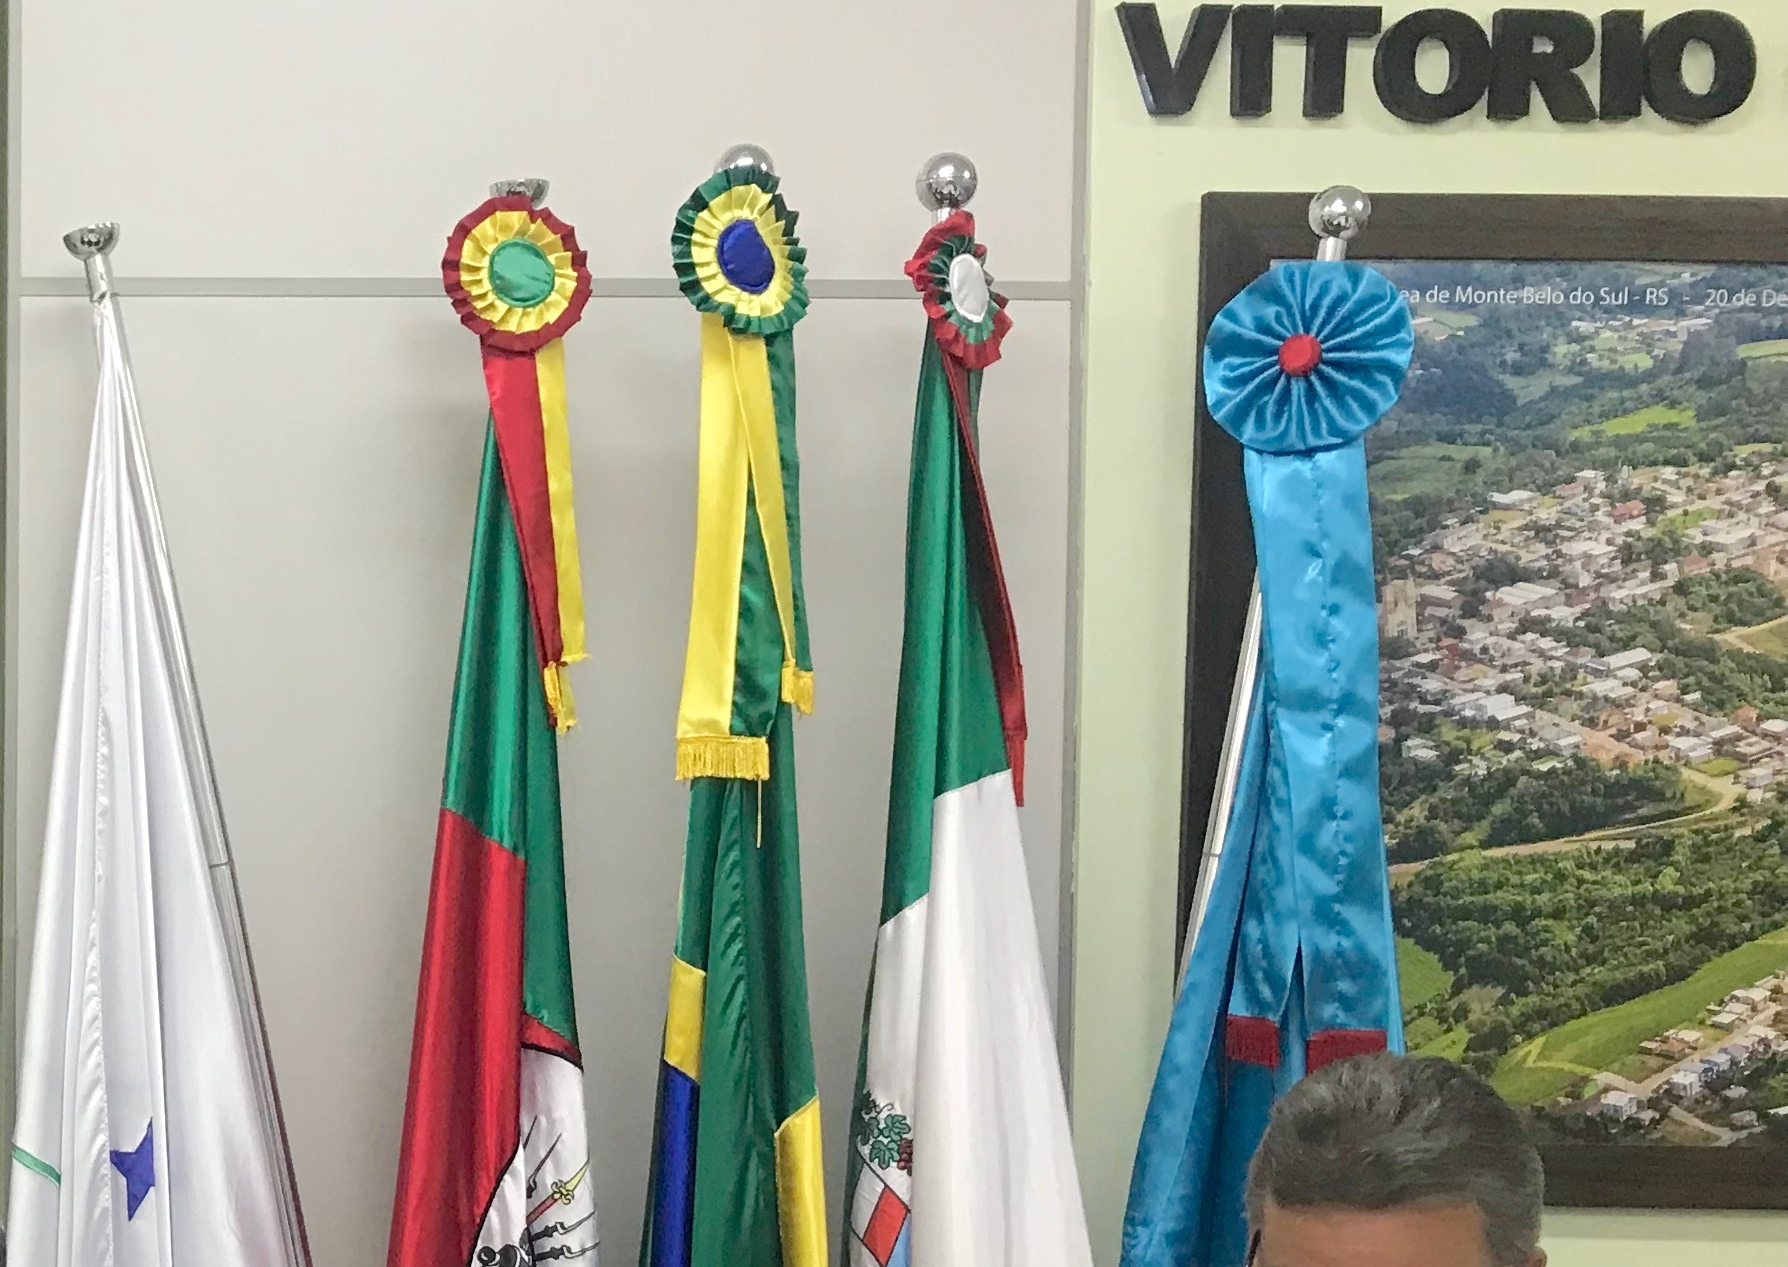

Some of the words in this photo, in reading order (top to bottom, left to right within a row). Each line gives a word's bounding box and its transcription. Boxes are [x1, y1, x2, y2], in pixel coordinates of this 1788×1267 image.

[1114, 3, 1757, 122] VITORIO
[1426, 285, 1450, 304] de
[1455, 285, 1517, 304] Monte
[1523, 286, 1564, 305] Belo
[1570, 286, 1594, 305] do
[1599, 286, 1629, 305] Sul
[1646, 287, 1669, 306] RS
[1705, 288, 1728, 307] 20
[1732, 288, 1757, 307] de
